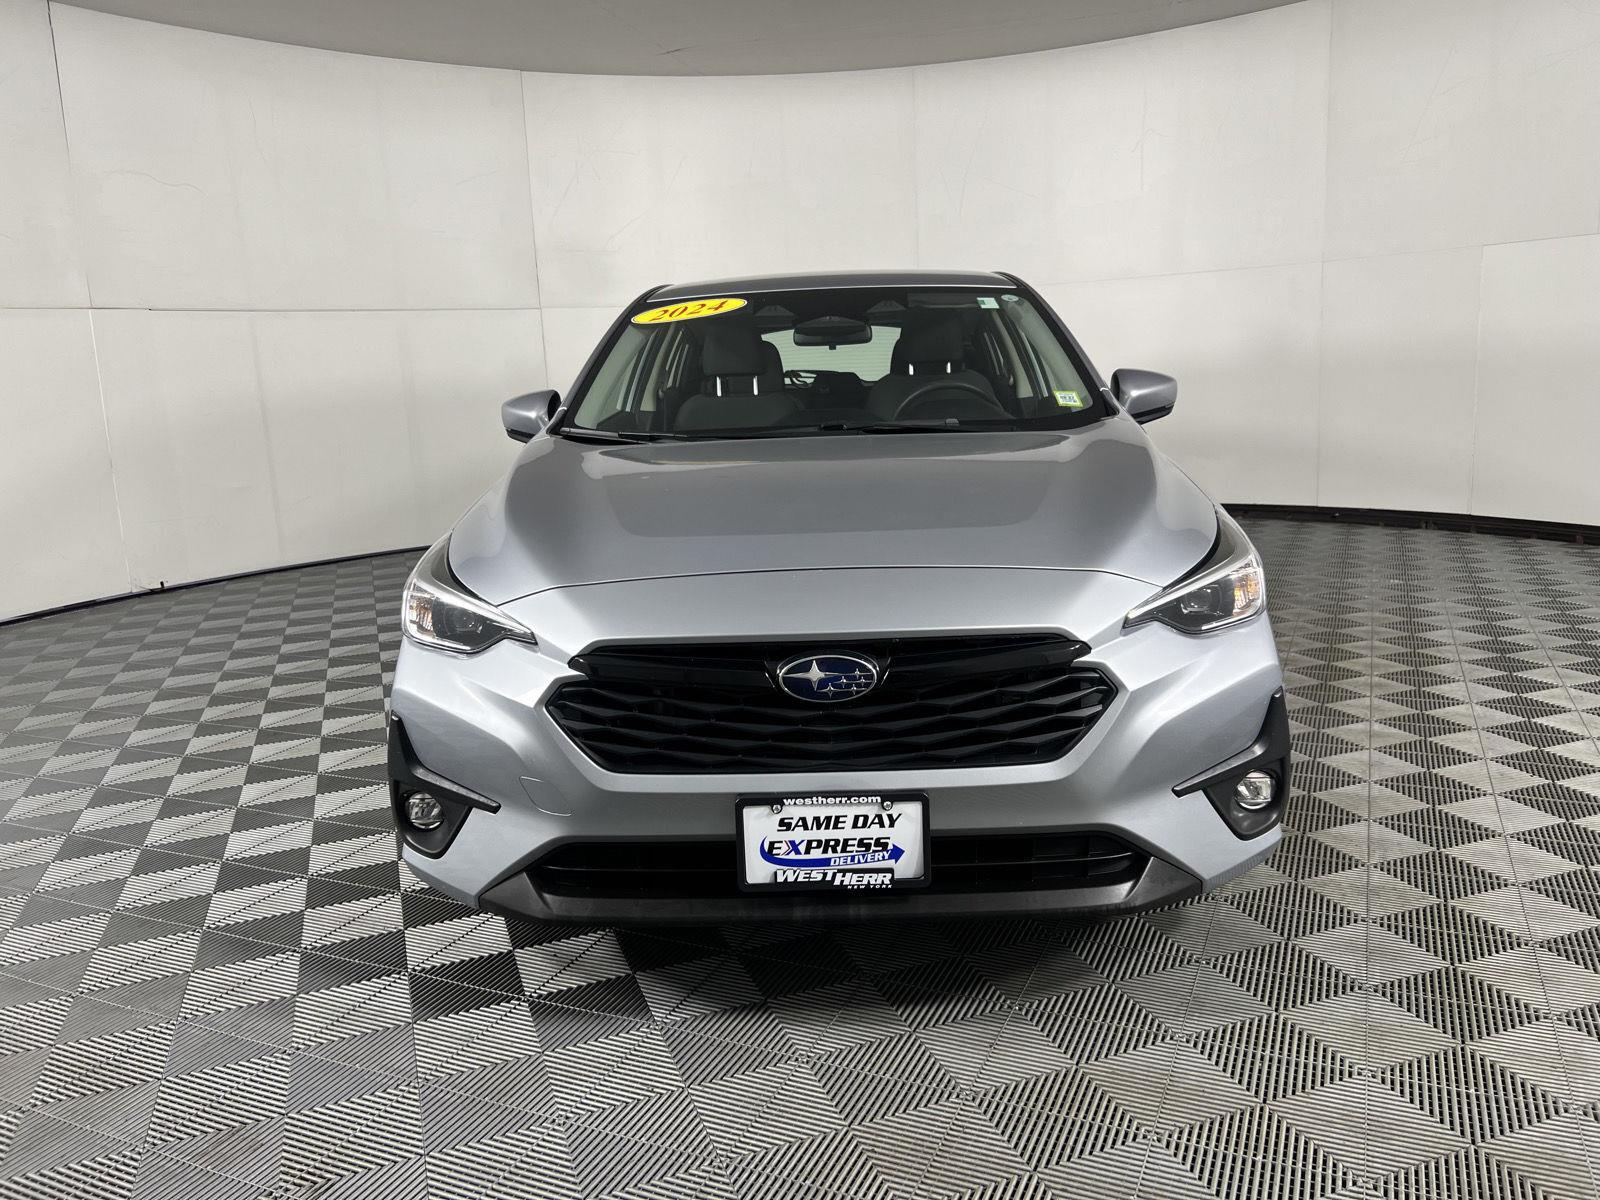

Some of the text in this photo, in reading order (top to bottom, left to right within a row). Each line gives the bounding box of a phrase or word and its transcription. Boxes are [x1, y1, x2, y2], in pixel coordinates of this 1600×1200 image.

[649, 300, 728, 321] 2024
[783, 796, 881, 806] westherr.com
[777, 813, 902, 831] SAME DAY
[766, 837, 891, 856] EXPRESS
[830, 850, 891, 866] DELIVERY
